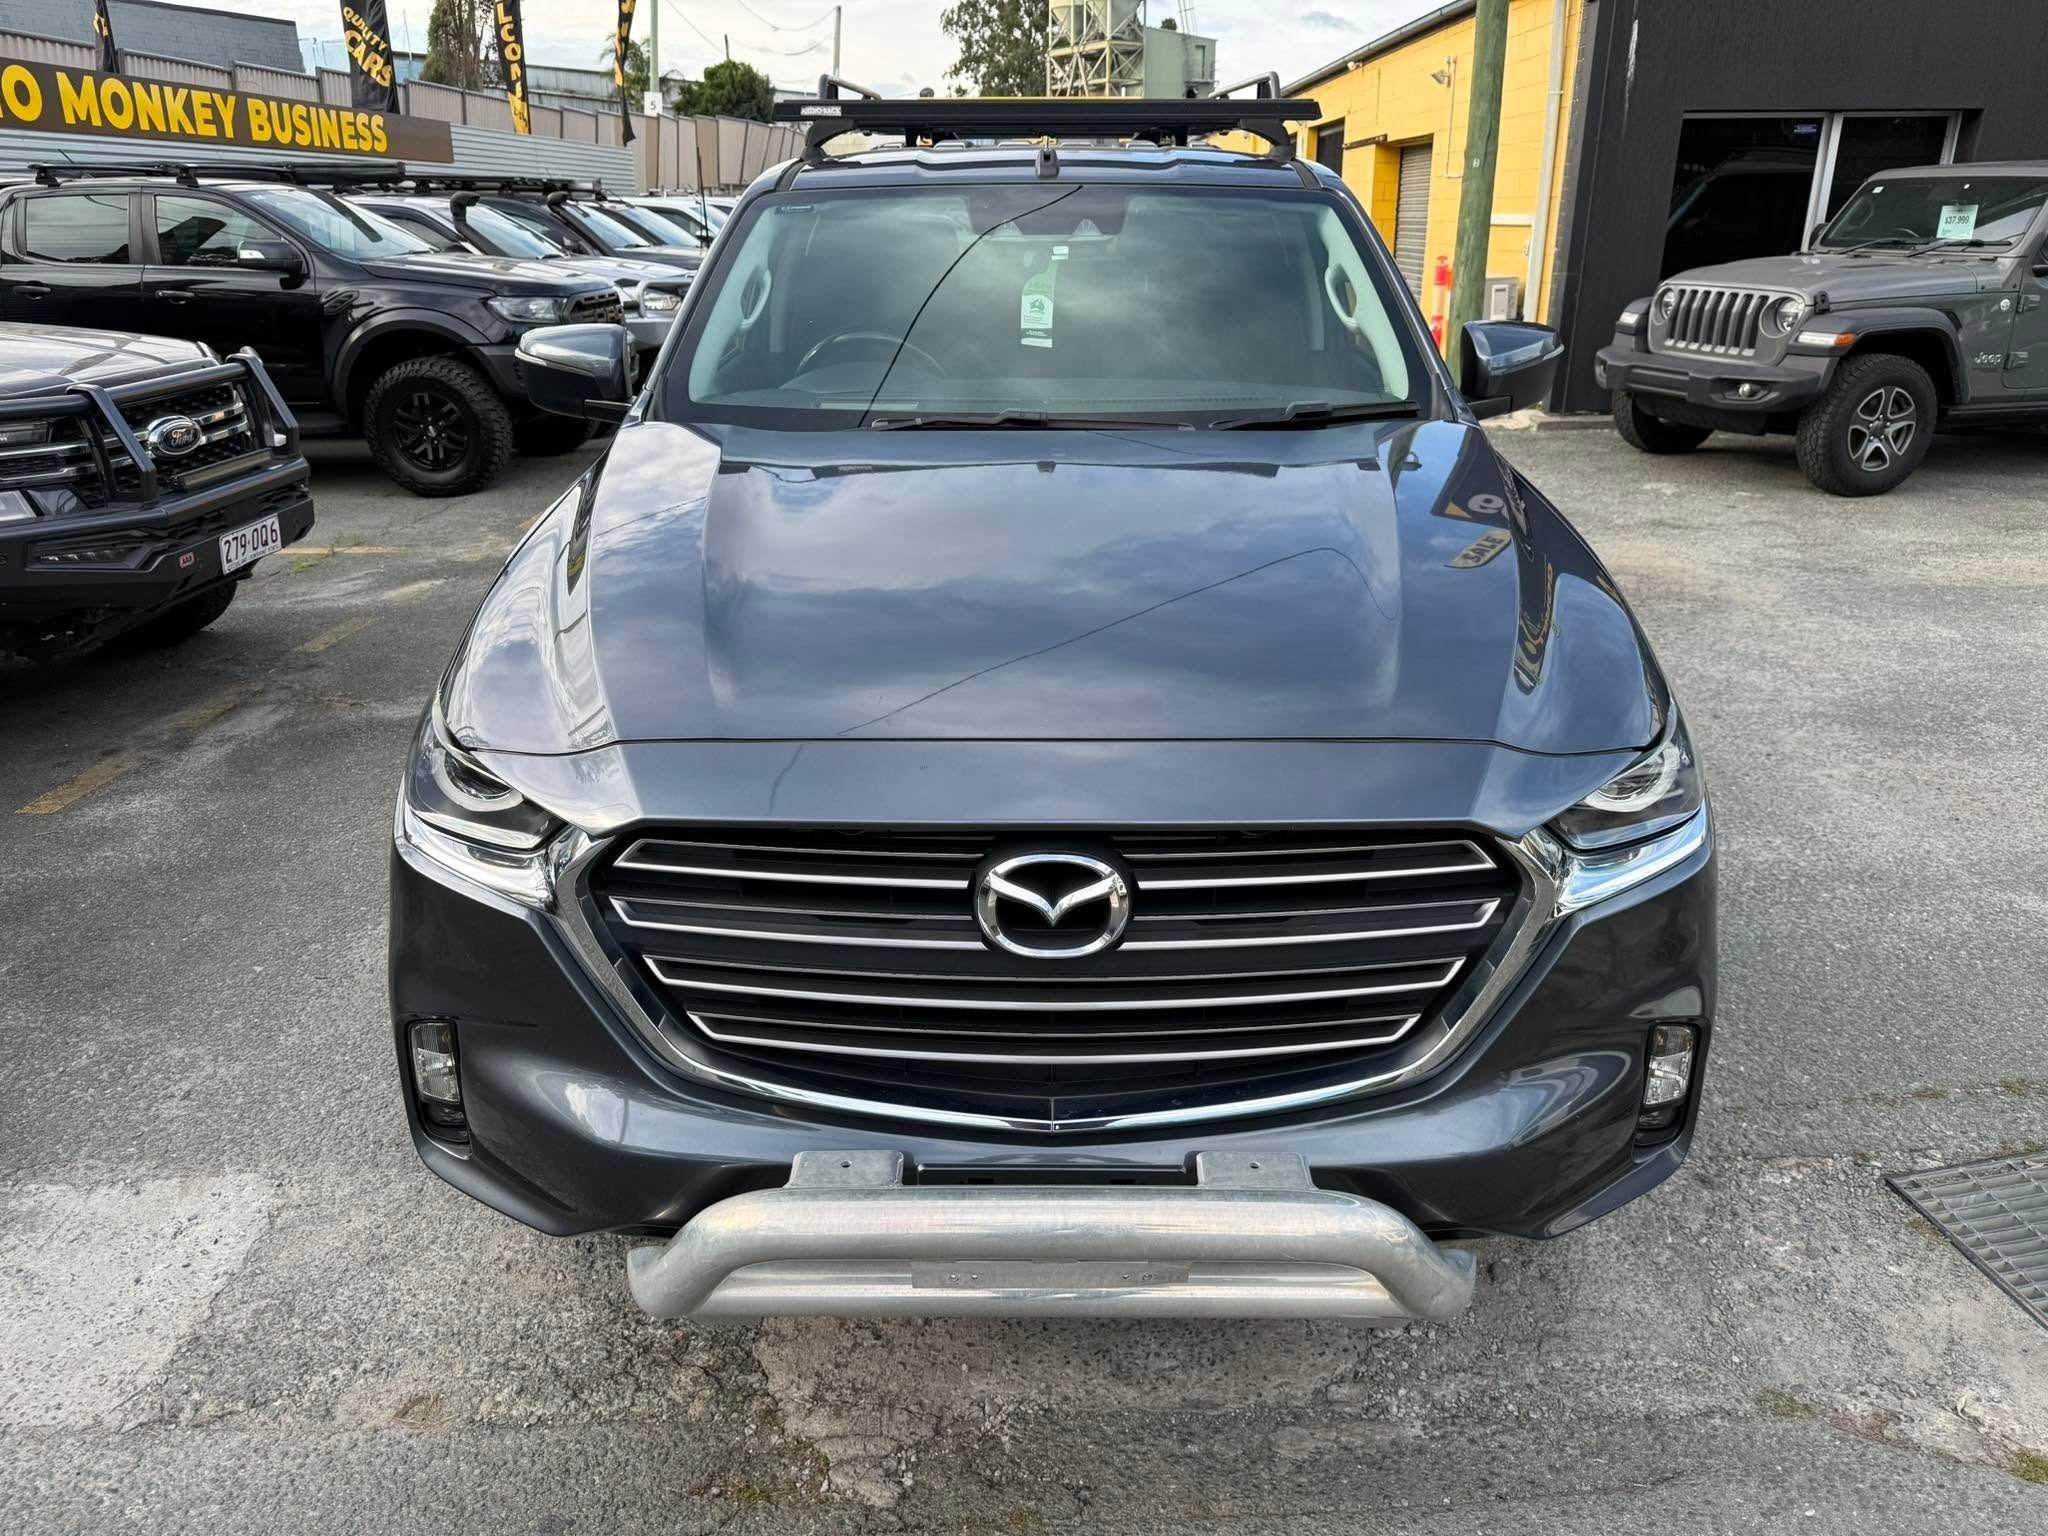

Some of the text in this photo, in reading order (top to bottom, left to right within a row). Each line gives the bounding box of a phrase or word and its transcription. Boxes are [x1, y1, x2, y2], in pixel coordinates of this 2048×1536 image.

[345, 30, 392, 87] CARS
[55, 71, 236, 139] MONKEY
[246, 98, 388, 153] BUSINESS
[1974, 351, 2002, 365] Jeep
[171, 428, 193, 446] Ford
